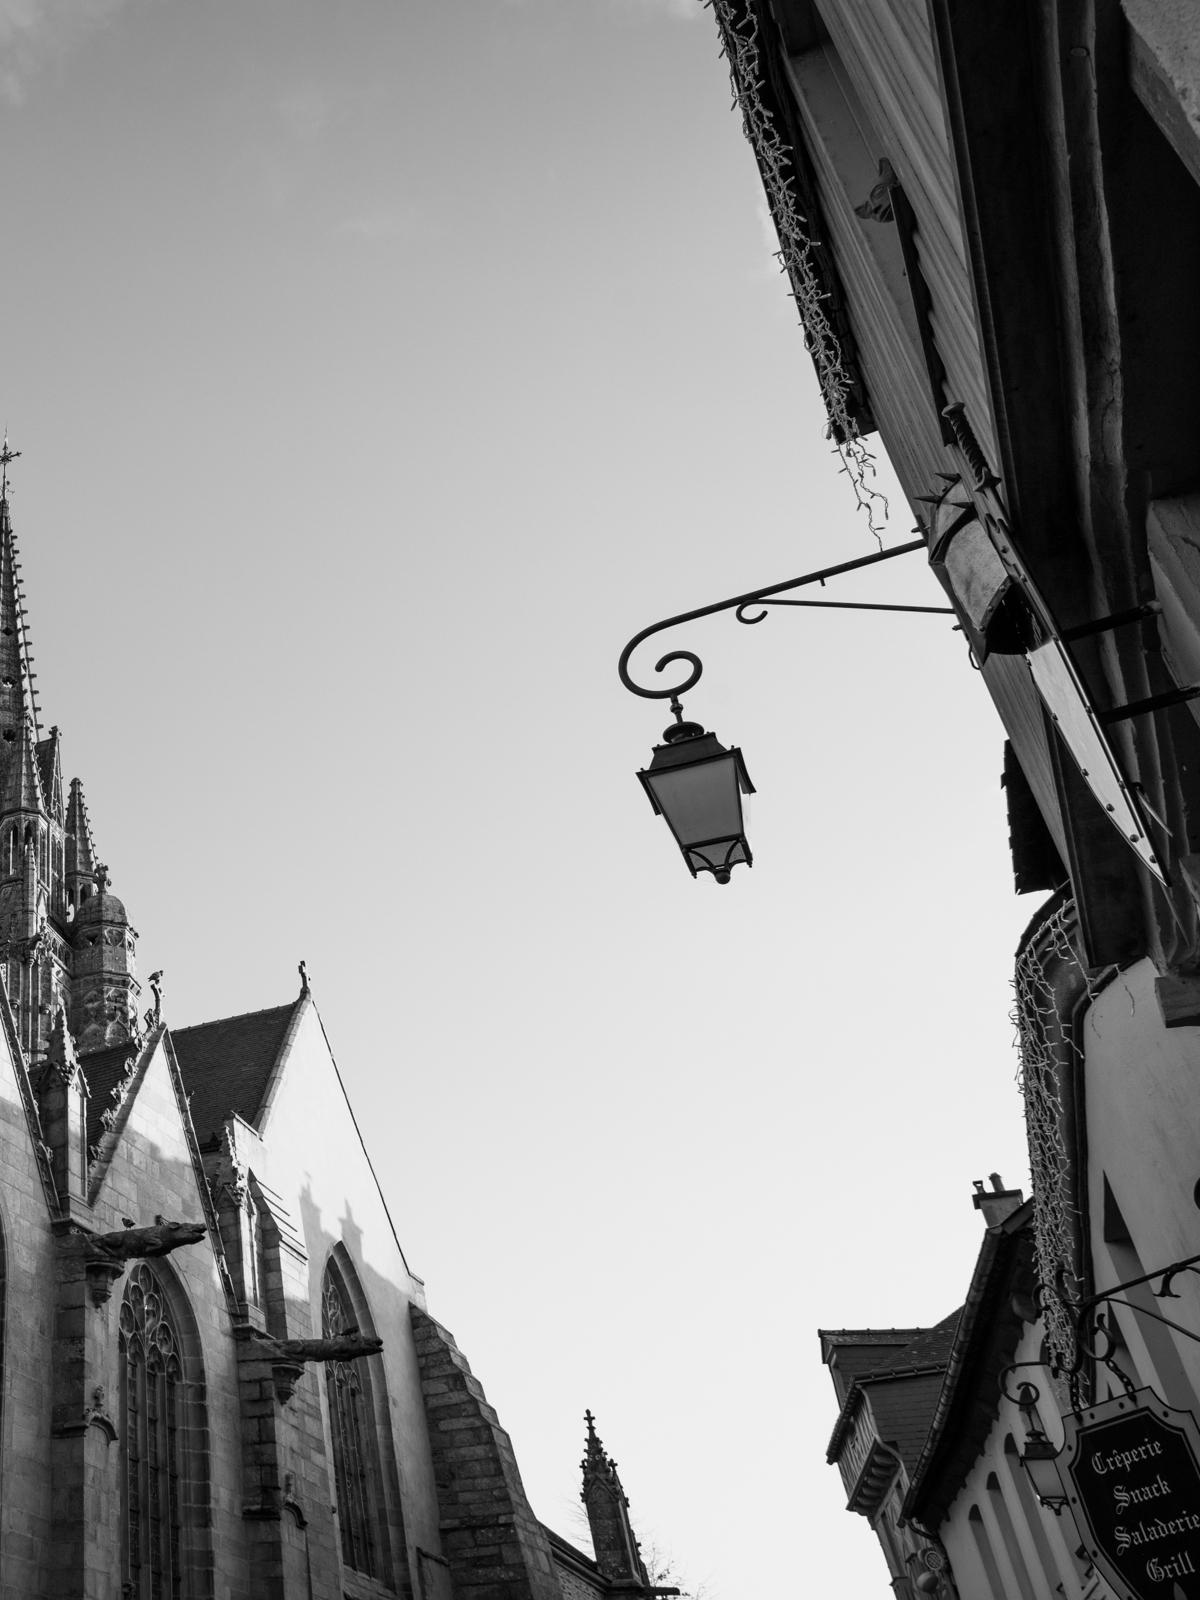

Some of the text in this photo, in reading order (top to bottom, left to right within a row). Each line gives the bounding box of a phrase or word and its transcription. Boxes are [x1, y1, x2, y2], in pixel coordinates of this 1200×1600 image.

[1091, 1438, 1163, 1474] Crêperie
[1113, 1474, 1171, 1514] Snack
[1114, 1510, 1200, 1556] Saladerie
[1146, 1551, 1195, 1582] Grill
